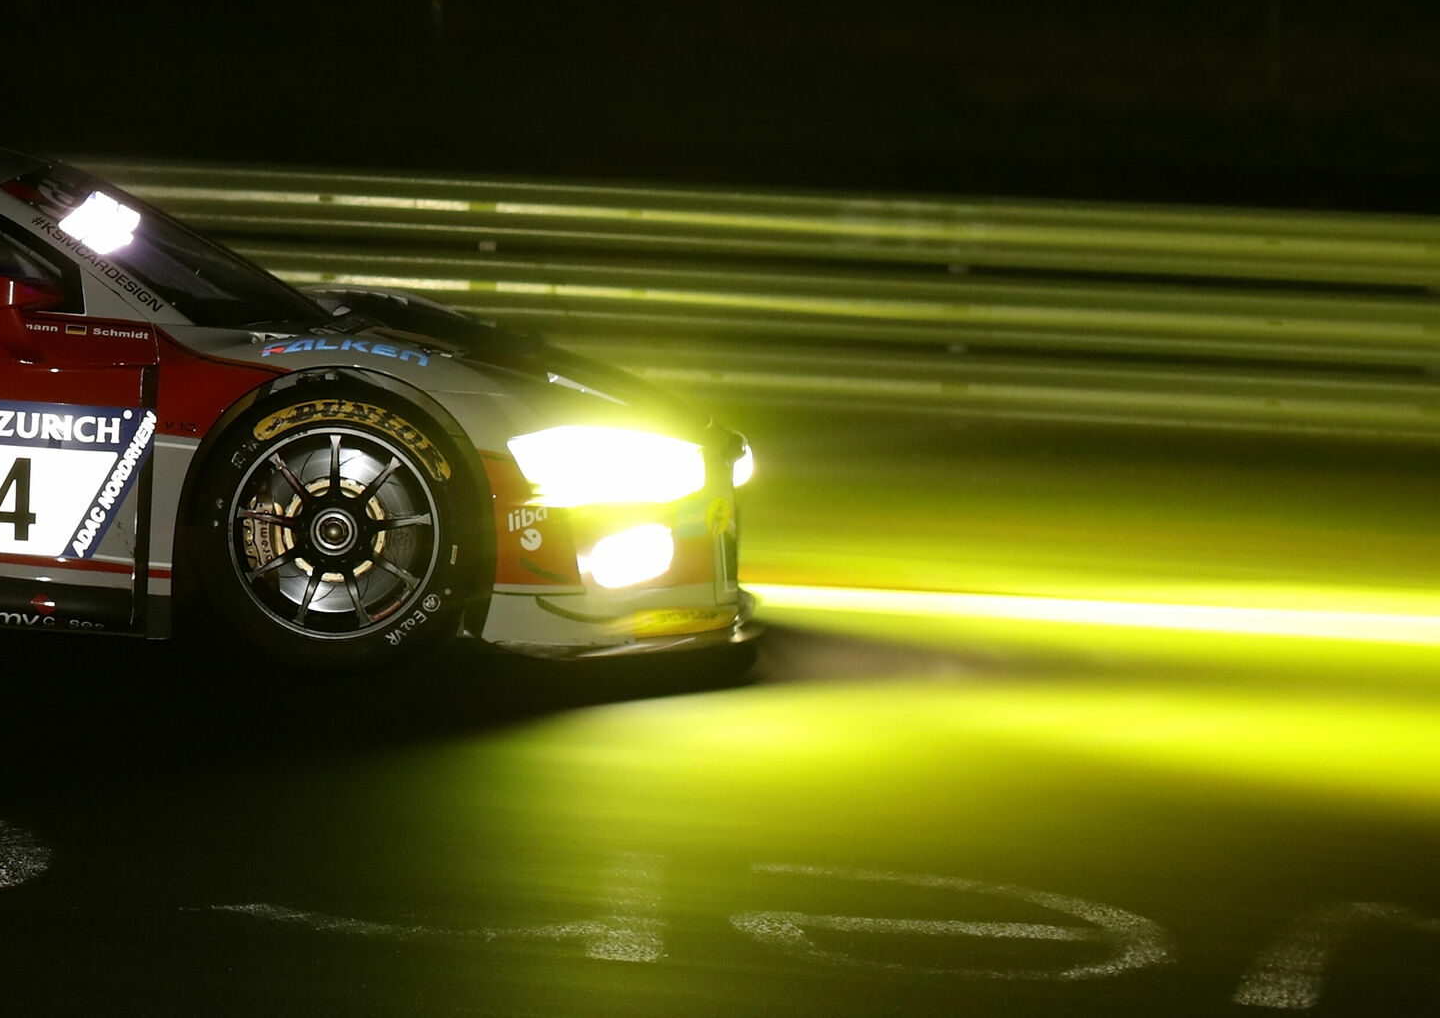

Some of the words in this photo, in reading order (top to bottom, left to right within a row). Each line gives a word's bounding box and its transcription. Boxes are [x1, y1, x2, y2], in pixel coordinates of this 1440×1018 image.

[93, 326, 150, 341] Schmidt
[260, 338, 429, 367] FALKEN
[70, 507, 107, 559] ADAC
[100, 410, 158, 511] NORDRHEIN
